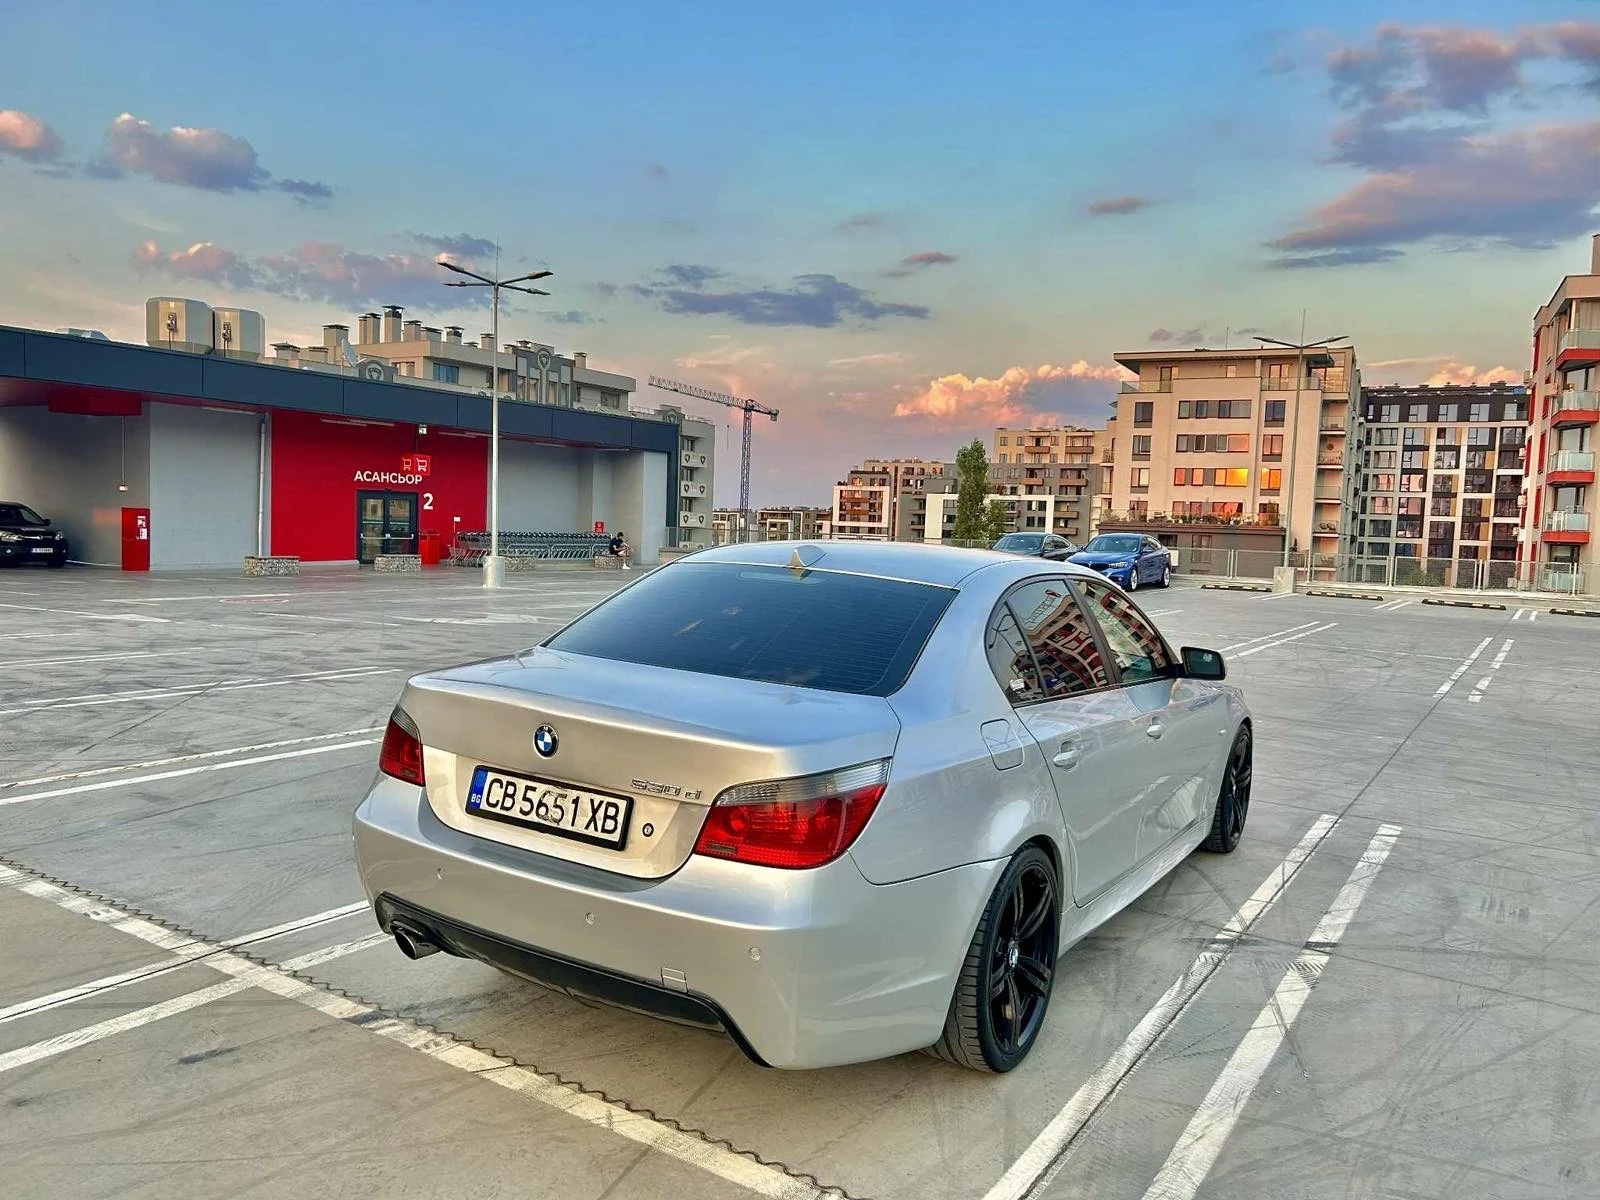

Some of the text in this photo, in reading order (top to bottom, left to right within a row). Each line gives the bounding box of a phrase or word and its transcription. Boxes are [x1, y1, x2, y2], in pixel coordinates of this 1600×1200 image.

[354, 471, 422, 484] АСАНСЬОР
[423, 493, 433, 510] 2
[471, 793, 482, 804] BG
